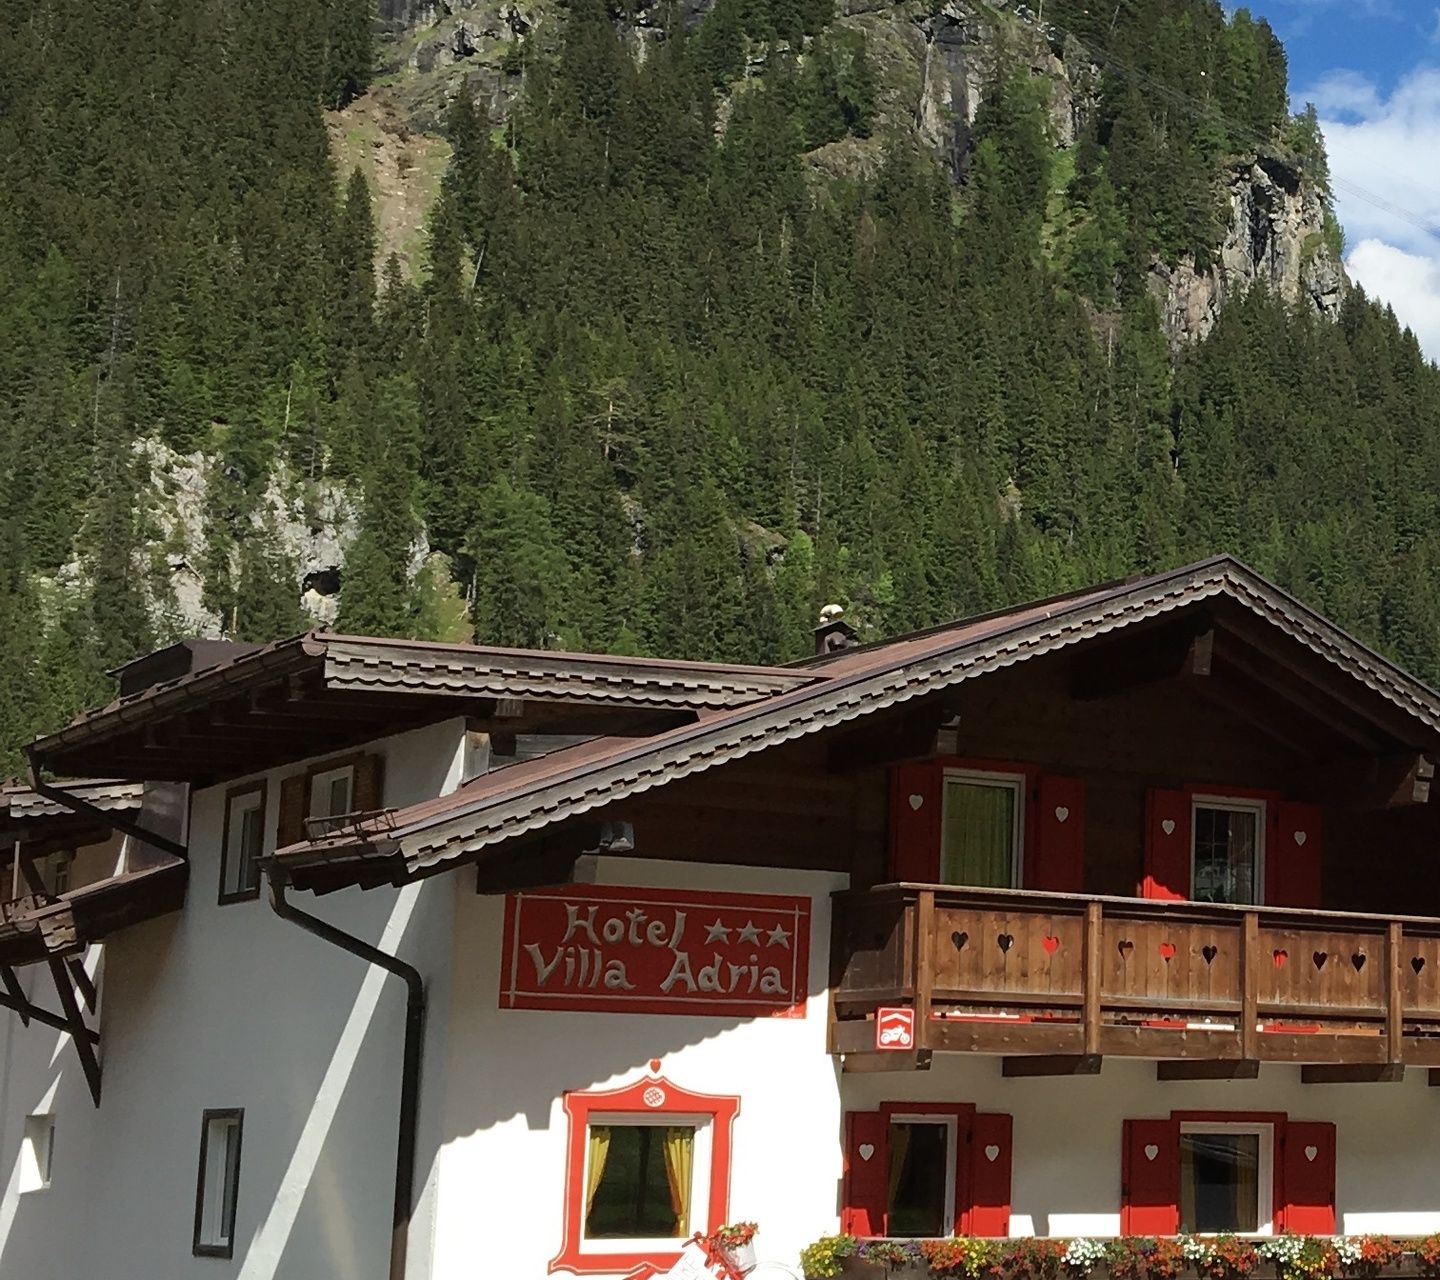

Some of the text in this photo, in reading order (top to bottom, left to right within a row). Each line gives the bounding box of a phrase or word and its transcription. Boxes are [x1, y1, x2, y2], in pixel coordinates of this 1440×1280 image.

[561, 902, 688, 949] Hotel
[523, 943, 790, 995] Villa Adria
